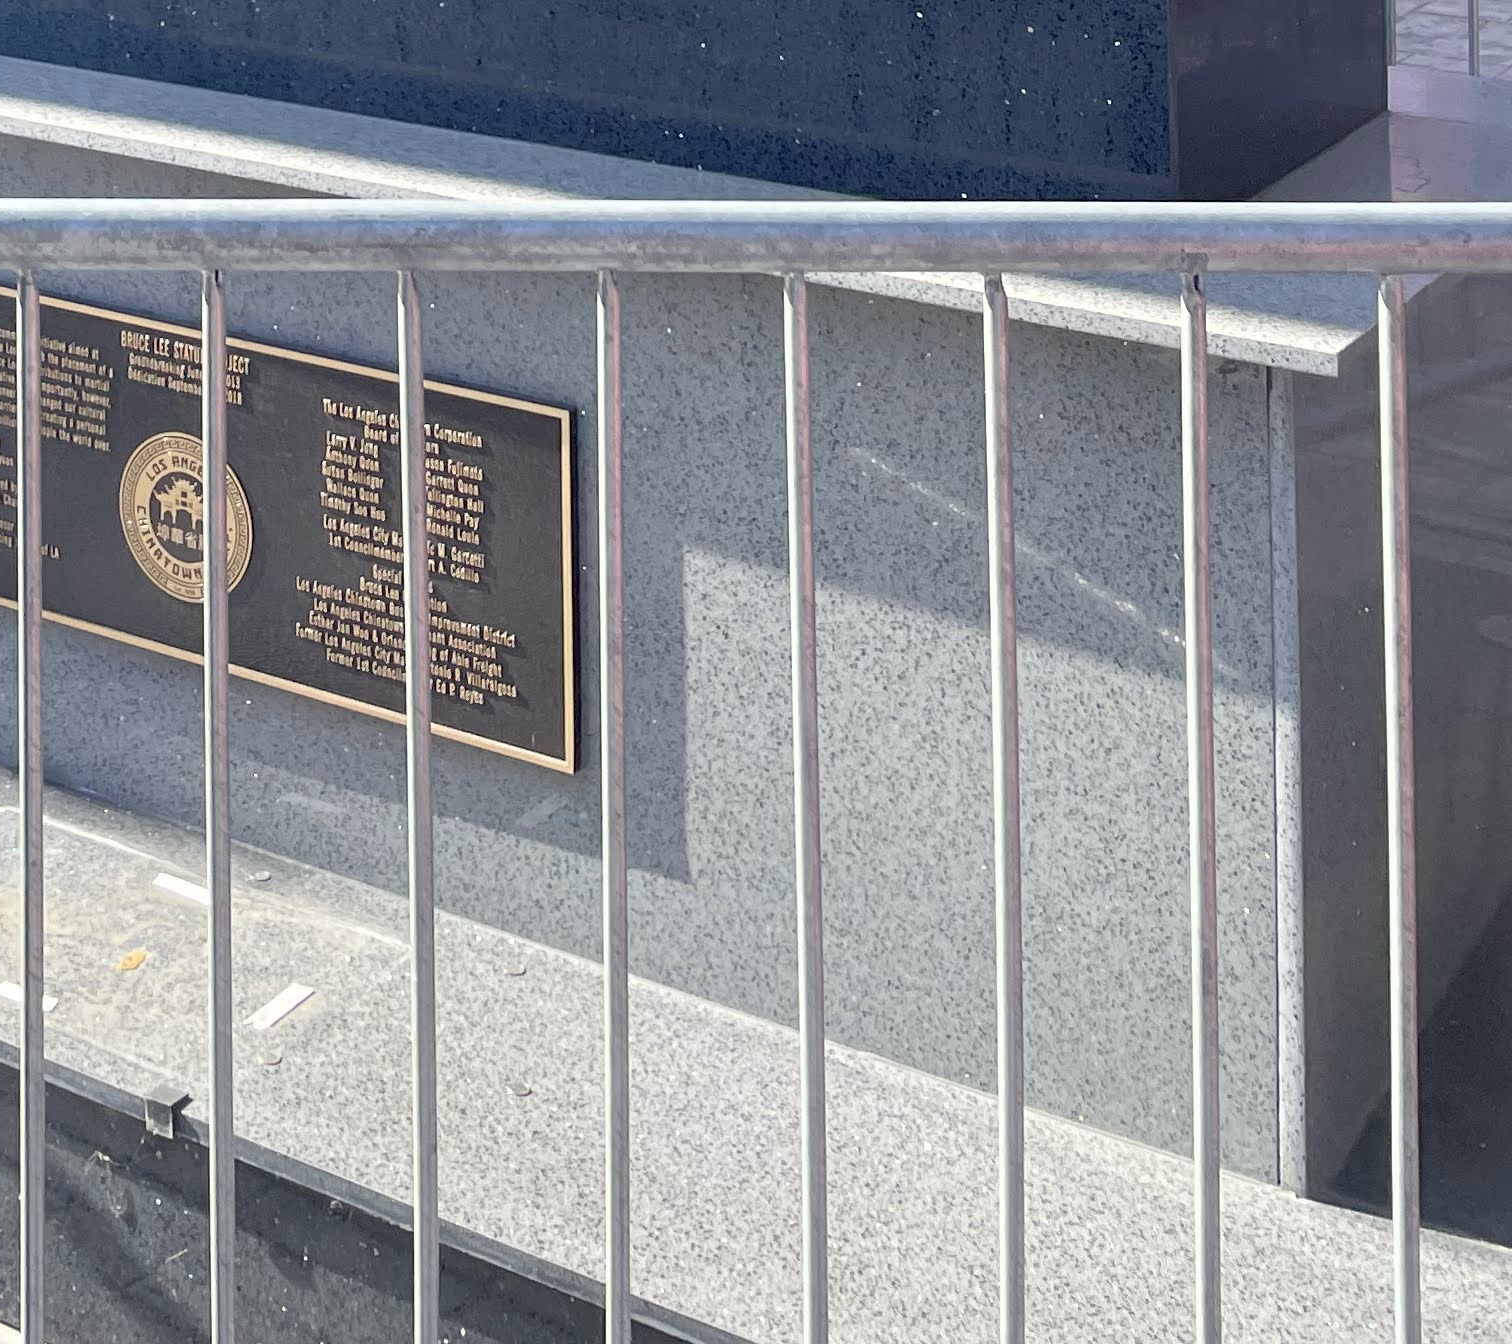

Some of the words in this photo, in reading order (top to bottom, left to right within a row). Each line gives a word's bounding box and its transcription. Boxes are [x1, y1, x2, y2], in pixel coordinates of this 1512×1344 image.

[47, 352, 59, 367] the
[120, 330, 150, 353] BRUCE
[153, 335, 170, 358] LEE
[173, 341, 203, 365] STATU
[226, 353, 251, 375] JECT
[127, 366, 166, 387] Dedication
[167, 376, 203, 396] Septembe
[226, 388, 243, 406] 018
[129, 353, 185, 379] Groundbreaking
[225, 373, 241, 390] 013
[58, 428, 71, 443] the
[322, 397, 337, 416] The
[339, 400, 354, 419] Los
[355, 405, 387, 428] Angeles
[433, 423, 482, 448] Corporation
[363, 424, 388, 443] Board
[390, 429, 400, 446] of
[326, 429, 348, 451] Larry
[145, 457, 168, 482] LOS
[172, 455, 203, 476] ANGE
[425, 457, 445, 472] ason
[425, 485, 464, 509] ellington
[466, 497, 484, 515] Hall
[136, 504, 203, 581] CHINATOWN
[322, 513, 337, 532] Los
[339, 517, 371, 539] Angeles
[372, 525, 390, 546] City
[425, 517, 454, 539] Ronald
[359, 576, 383, 596] Bruce
[385, 584, 400, 602] Lee
[372, 563, 402, 585] Special
[295, 575, 310, 593] Los
[312, 579, 343, 602] Angeles
[345, 587, 386, 613] Chinatown
[483, 625, 516, 648] District
[313, 596, 328, 613] Los
[330, 602, 361, 622] Angeles
[448, 634, 497, 659] Association
[295, 621, 322, 643] Former
[324, 631, 339, 649] Los
[341, 637, 372, 658] Angeles
[374, 645, 392, 665] City
[308, 609, 335, 631] Esther
[371, 627, 379, 645] &
[439, 645, 449, 664] of
[326, 647, 354, 668] Former
[435, 678, 447, 696] Ed
